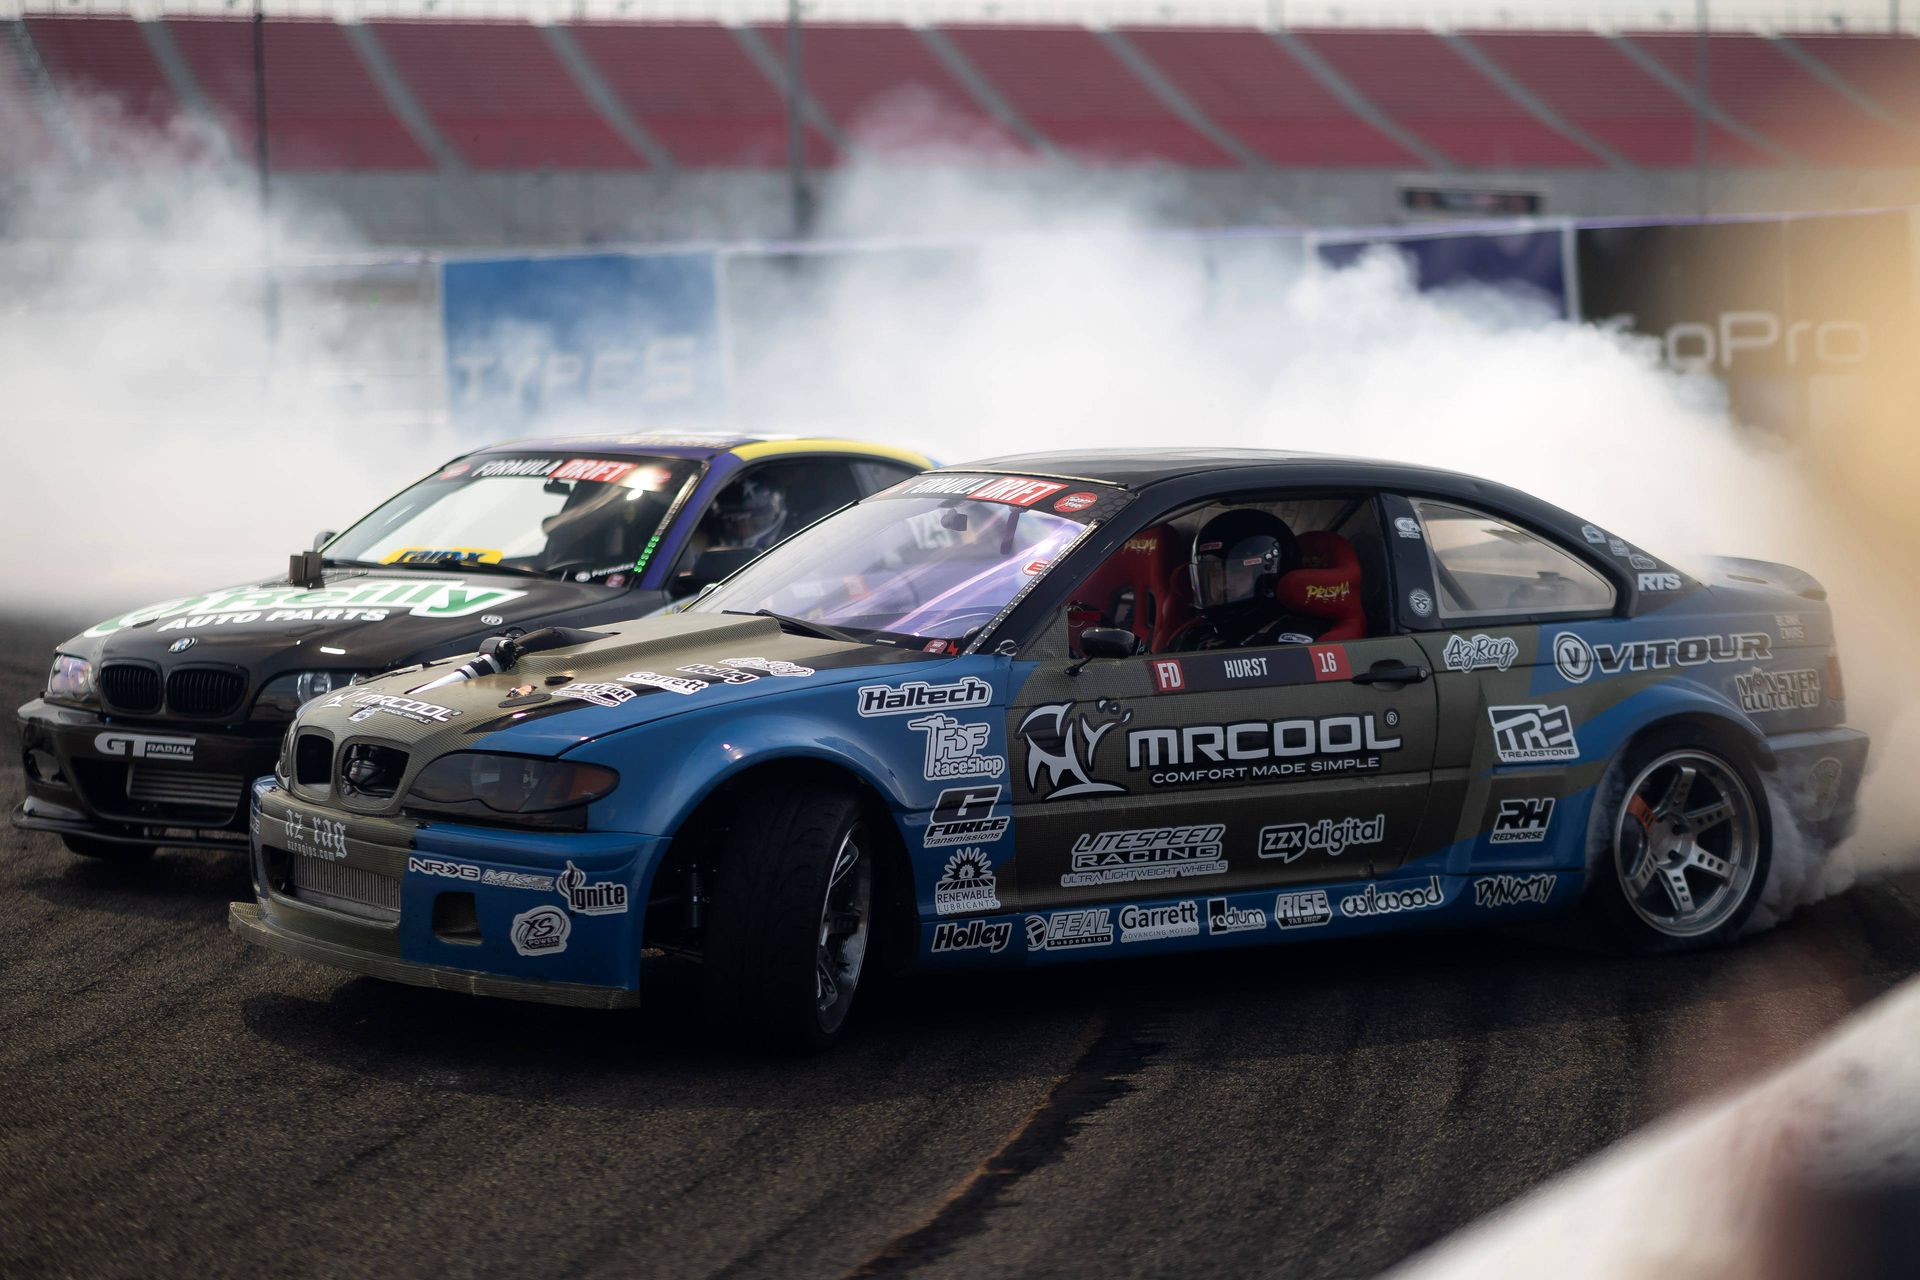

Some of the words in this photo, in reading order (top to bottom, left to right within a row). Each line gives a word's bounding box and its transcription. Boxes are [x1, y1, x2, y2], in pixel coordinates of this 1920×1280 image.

[471, 458, 563, 478] FORMULA
[553, 458, 634, 482] DRIFT
[901, 477, 995, 495] FORMULA
[971, 477, 1063, 504] DRIFT
[1637, 573, 1682, 591] RTS
[157, 609, 262, 633] AUTO
[266, 607, 389, 623] PARTS
[1317, 652, 1338, 674] 16
[1595, 633, 1772, 673] VITOUR
[1157, 661, 1181, 689] FD
[1223, 657, 1268, 679] HURST
[630, 672, 708, 691] Garrett
[863, 681, 987, 711] Haltech
[146, 743, 194, 755] RADIAL
[1128, 714, 1402, 769] MRCOOL
[1500, 748, 1576, 759] TREADSTONE
[932, 757, 1003, 777] RaceShop
[1151, 766, 1248, 784] COMFORT
[1252, 762, 1306, 776] MADE
[1311, 757, 1380, 772] SIMPLE
[1495, 800, 1554, 830] RH
[925, 831, 1000, 846] Transmissions
[926, 817, 1009, 838] FORCE
[1306, 815, 1384, 854] digital
[1491, 831, 1544, 842] REDHORSE
[1072, 825, 1225, 854] LITESPEED
[1076, 845, 1219, 868] RACING
[1062, 873, 1102, 885] ULTRA
[1181, 861, 1227, 874] WHEELS
[937, 888, 994, 904] RENEWABLE
[937, 900, 996, 913] LUBRICANTS
[1278, 893, 1329, 918] RISE
[1341, 875, 1443, 916] wilwood
[520, 917, 553, 937] XS
[1050, 909, 1111, 939] FEAL
[1120, 902, 1197, 930] Garrett
[1210, 906, 1266, 927] radium
[527, 935, 560, 946] POWER
[933, 920, 1011, 953] Holley
[1049, 935, 1109, 946] Suspension
[1122, 930, 1167, 941] ADVANCING
[1168, 927, 1199, 937] MOTION
